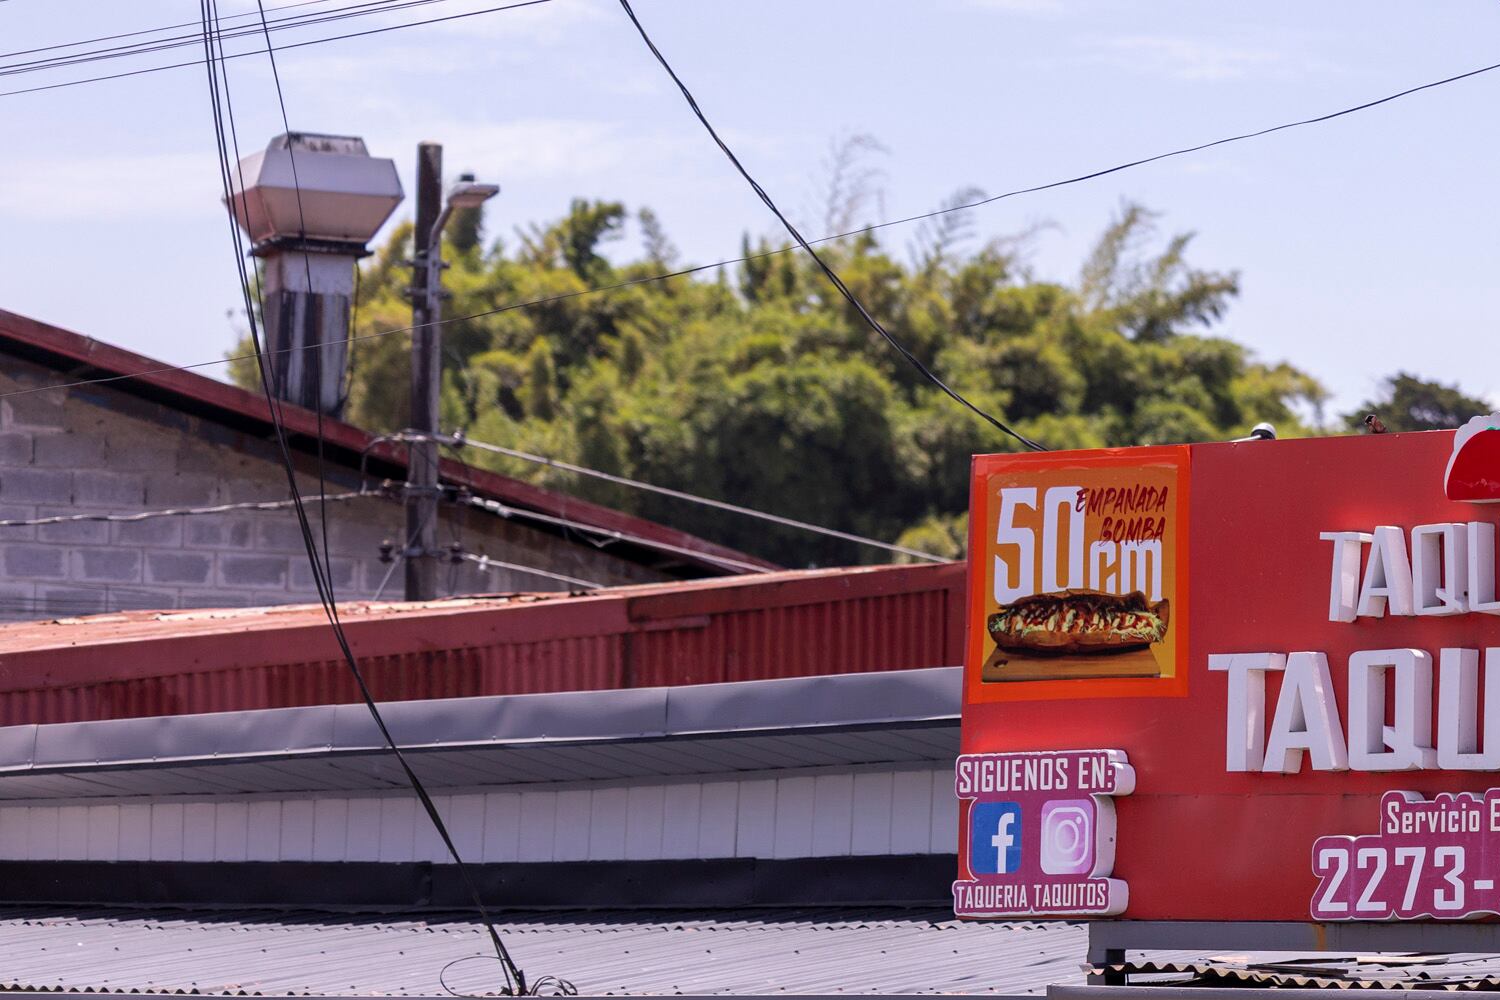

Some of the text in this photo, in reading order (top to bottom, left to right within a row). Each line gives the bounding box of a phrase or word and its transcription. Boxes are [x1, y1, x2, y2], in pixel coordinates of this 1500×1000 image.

[1076, 484, 1168, 517] EMPANADA
[994, 486, 1163, 605] 50cm
[959, 757, 1112, 793] SIGUENOS EN:
[1387, 801, 1480, 833] Servicio
[957, 883, 1106, 909] TAQUERIA TAQUITOS
